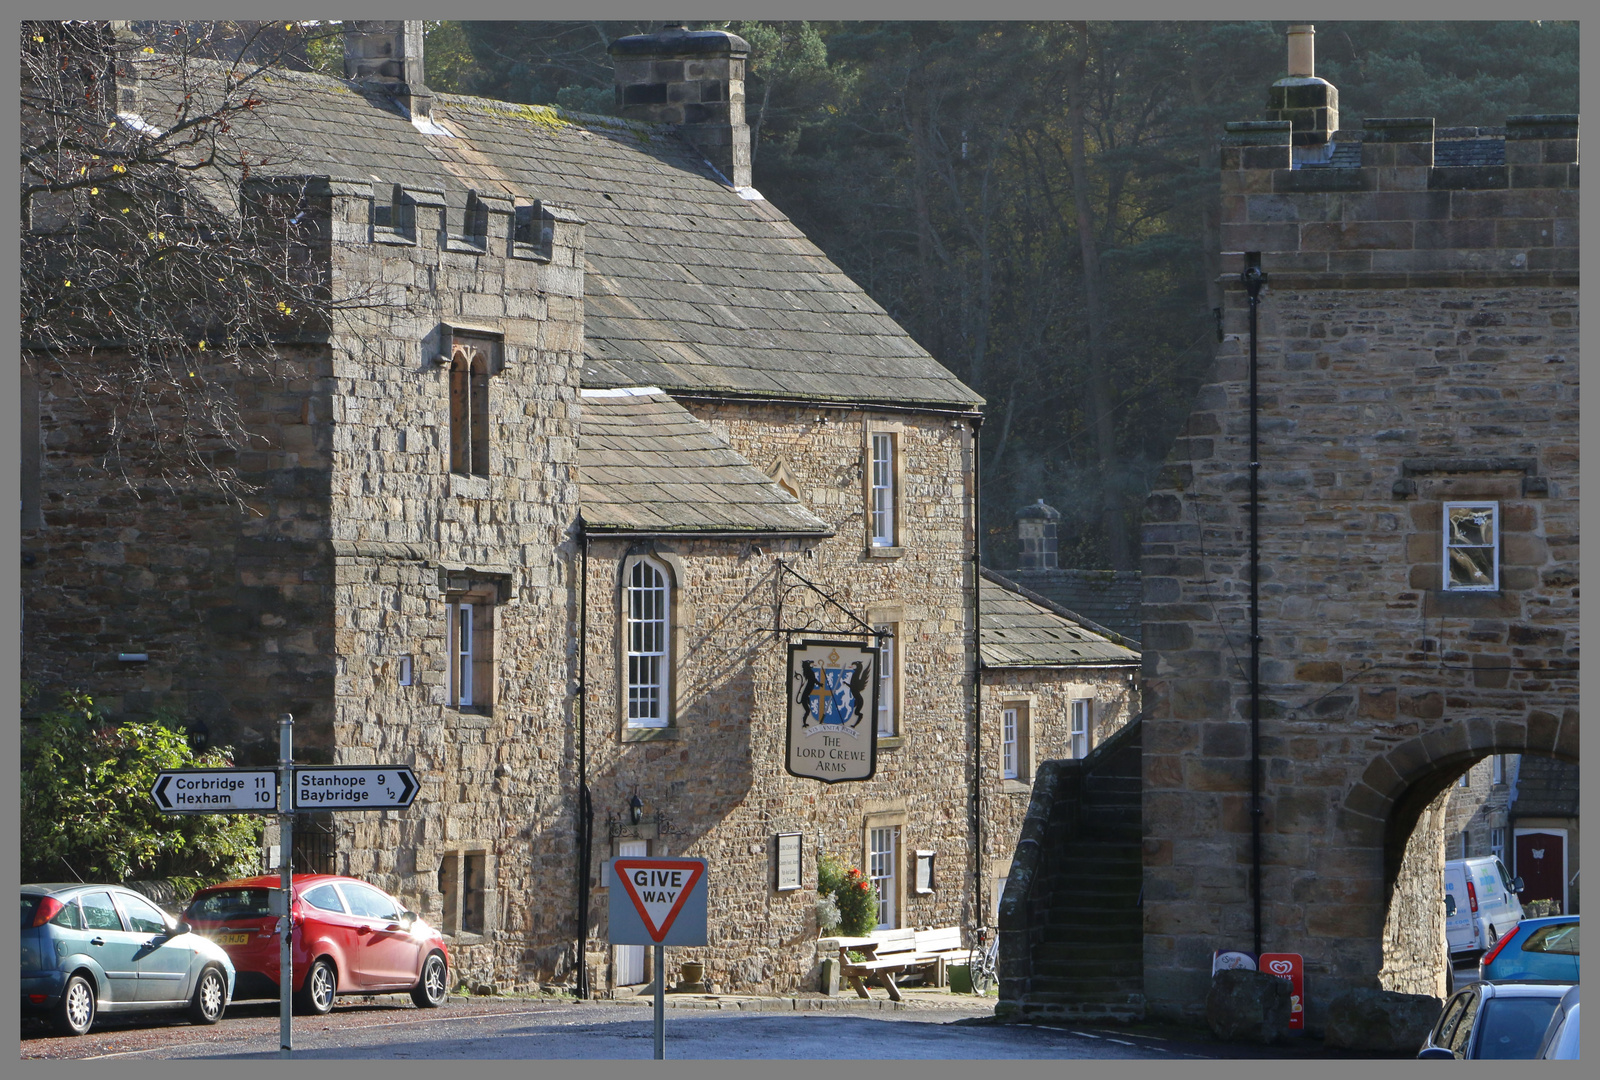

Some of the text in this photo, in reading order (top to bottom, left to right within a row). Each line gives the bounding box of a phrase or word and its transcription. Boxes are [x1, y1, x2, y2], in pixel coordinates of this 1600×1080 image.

[823, 735, 841, 746] THE
[797, 747, 866, 761] LORD CREWE
[815, 761, 847, 772] ARMS
[176, 777, 266, 791] Corbridge 11
[301, 774, 386, 787] Stanhope 9
[176, 791, 271, 804] Hexham 10
[301, 789, 369, 802] Baybridge
[633, 870, 682, 888] GIVE
[643, 891, 676, 903] WAY
